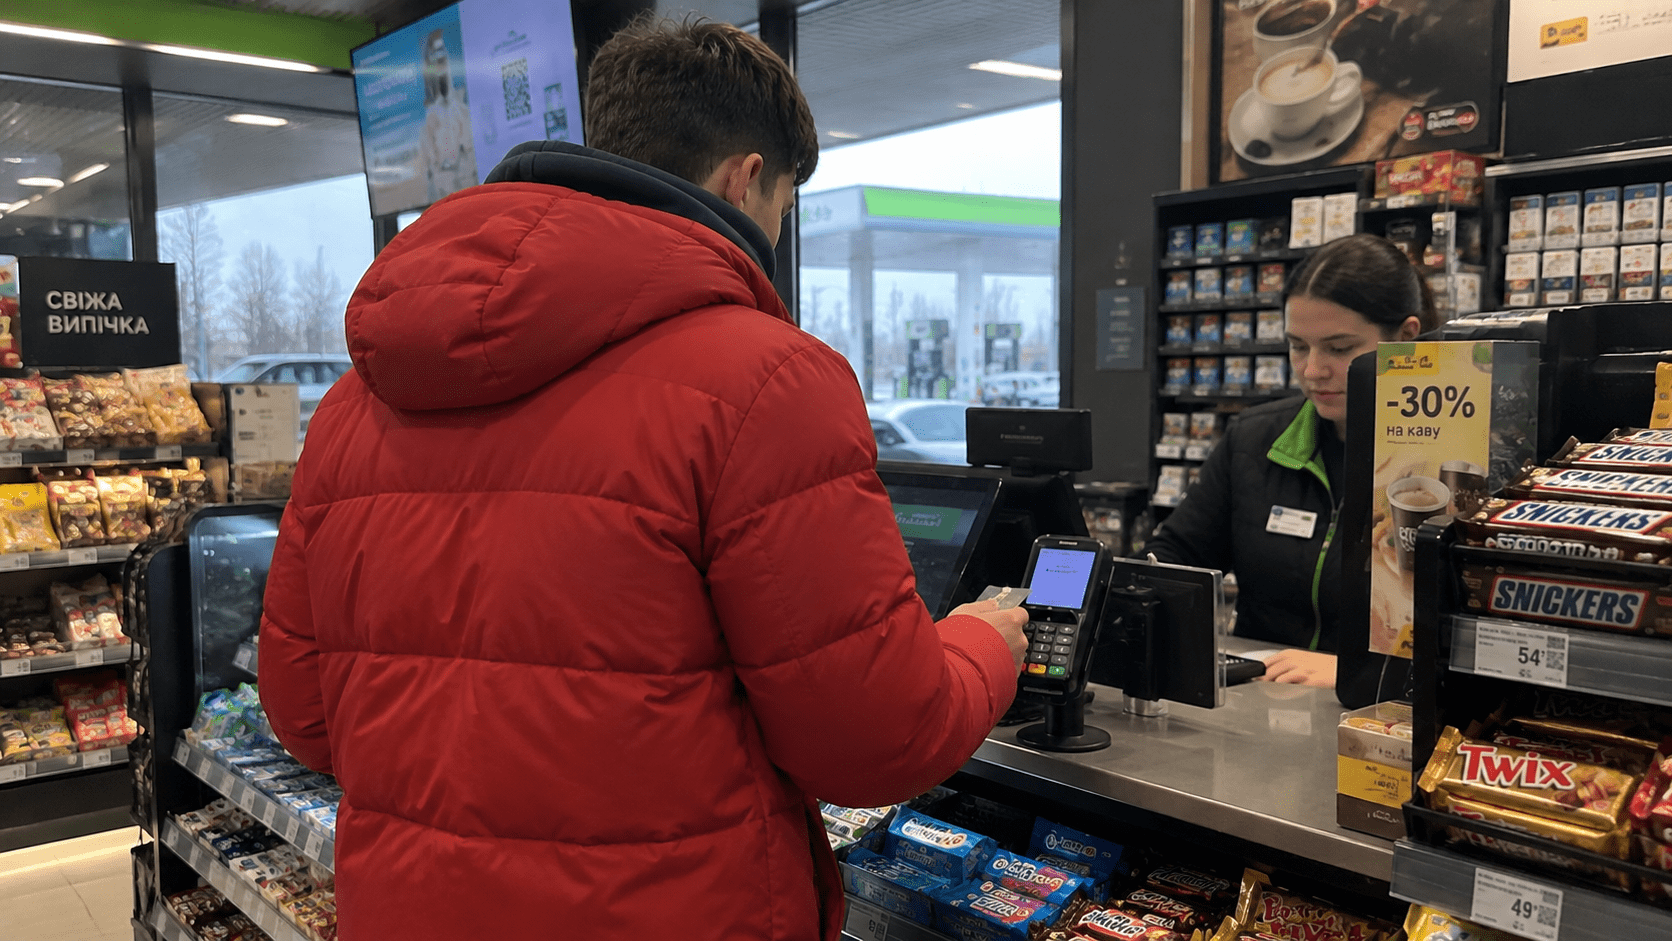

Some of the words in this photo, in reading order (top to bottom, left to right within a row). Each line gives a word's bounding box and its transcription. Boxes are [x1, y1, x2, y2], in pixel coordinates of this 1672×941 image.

[46, 290, 123, 310] СВІЖА
[48, 314, 150, 334] ВИПІЧКА
[1386, 385, 1475, 418] -30%
[1386, 426, 1403, 437] на
[1407, 426, 1441, 440] каву
[1494, 580, 1639, 624] SNICKERS
[1458, 744, 1577, 789] Twix
